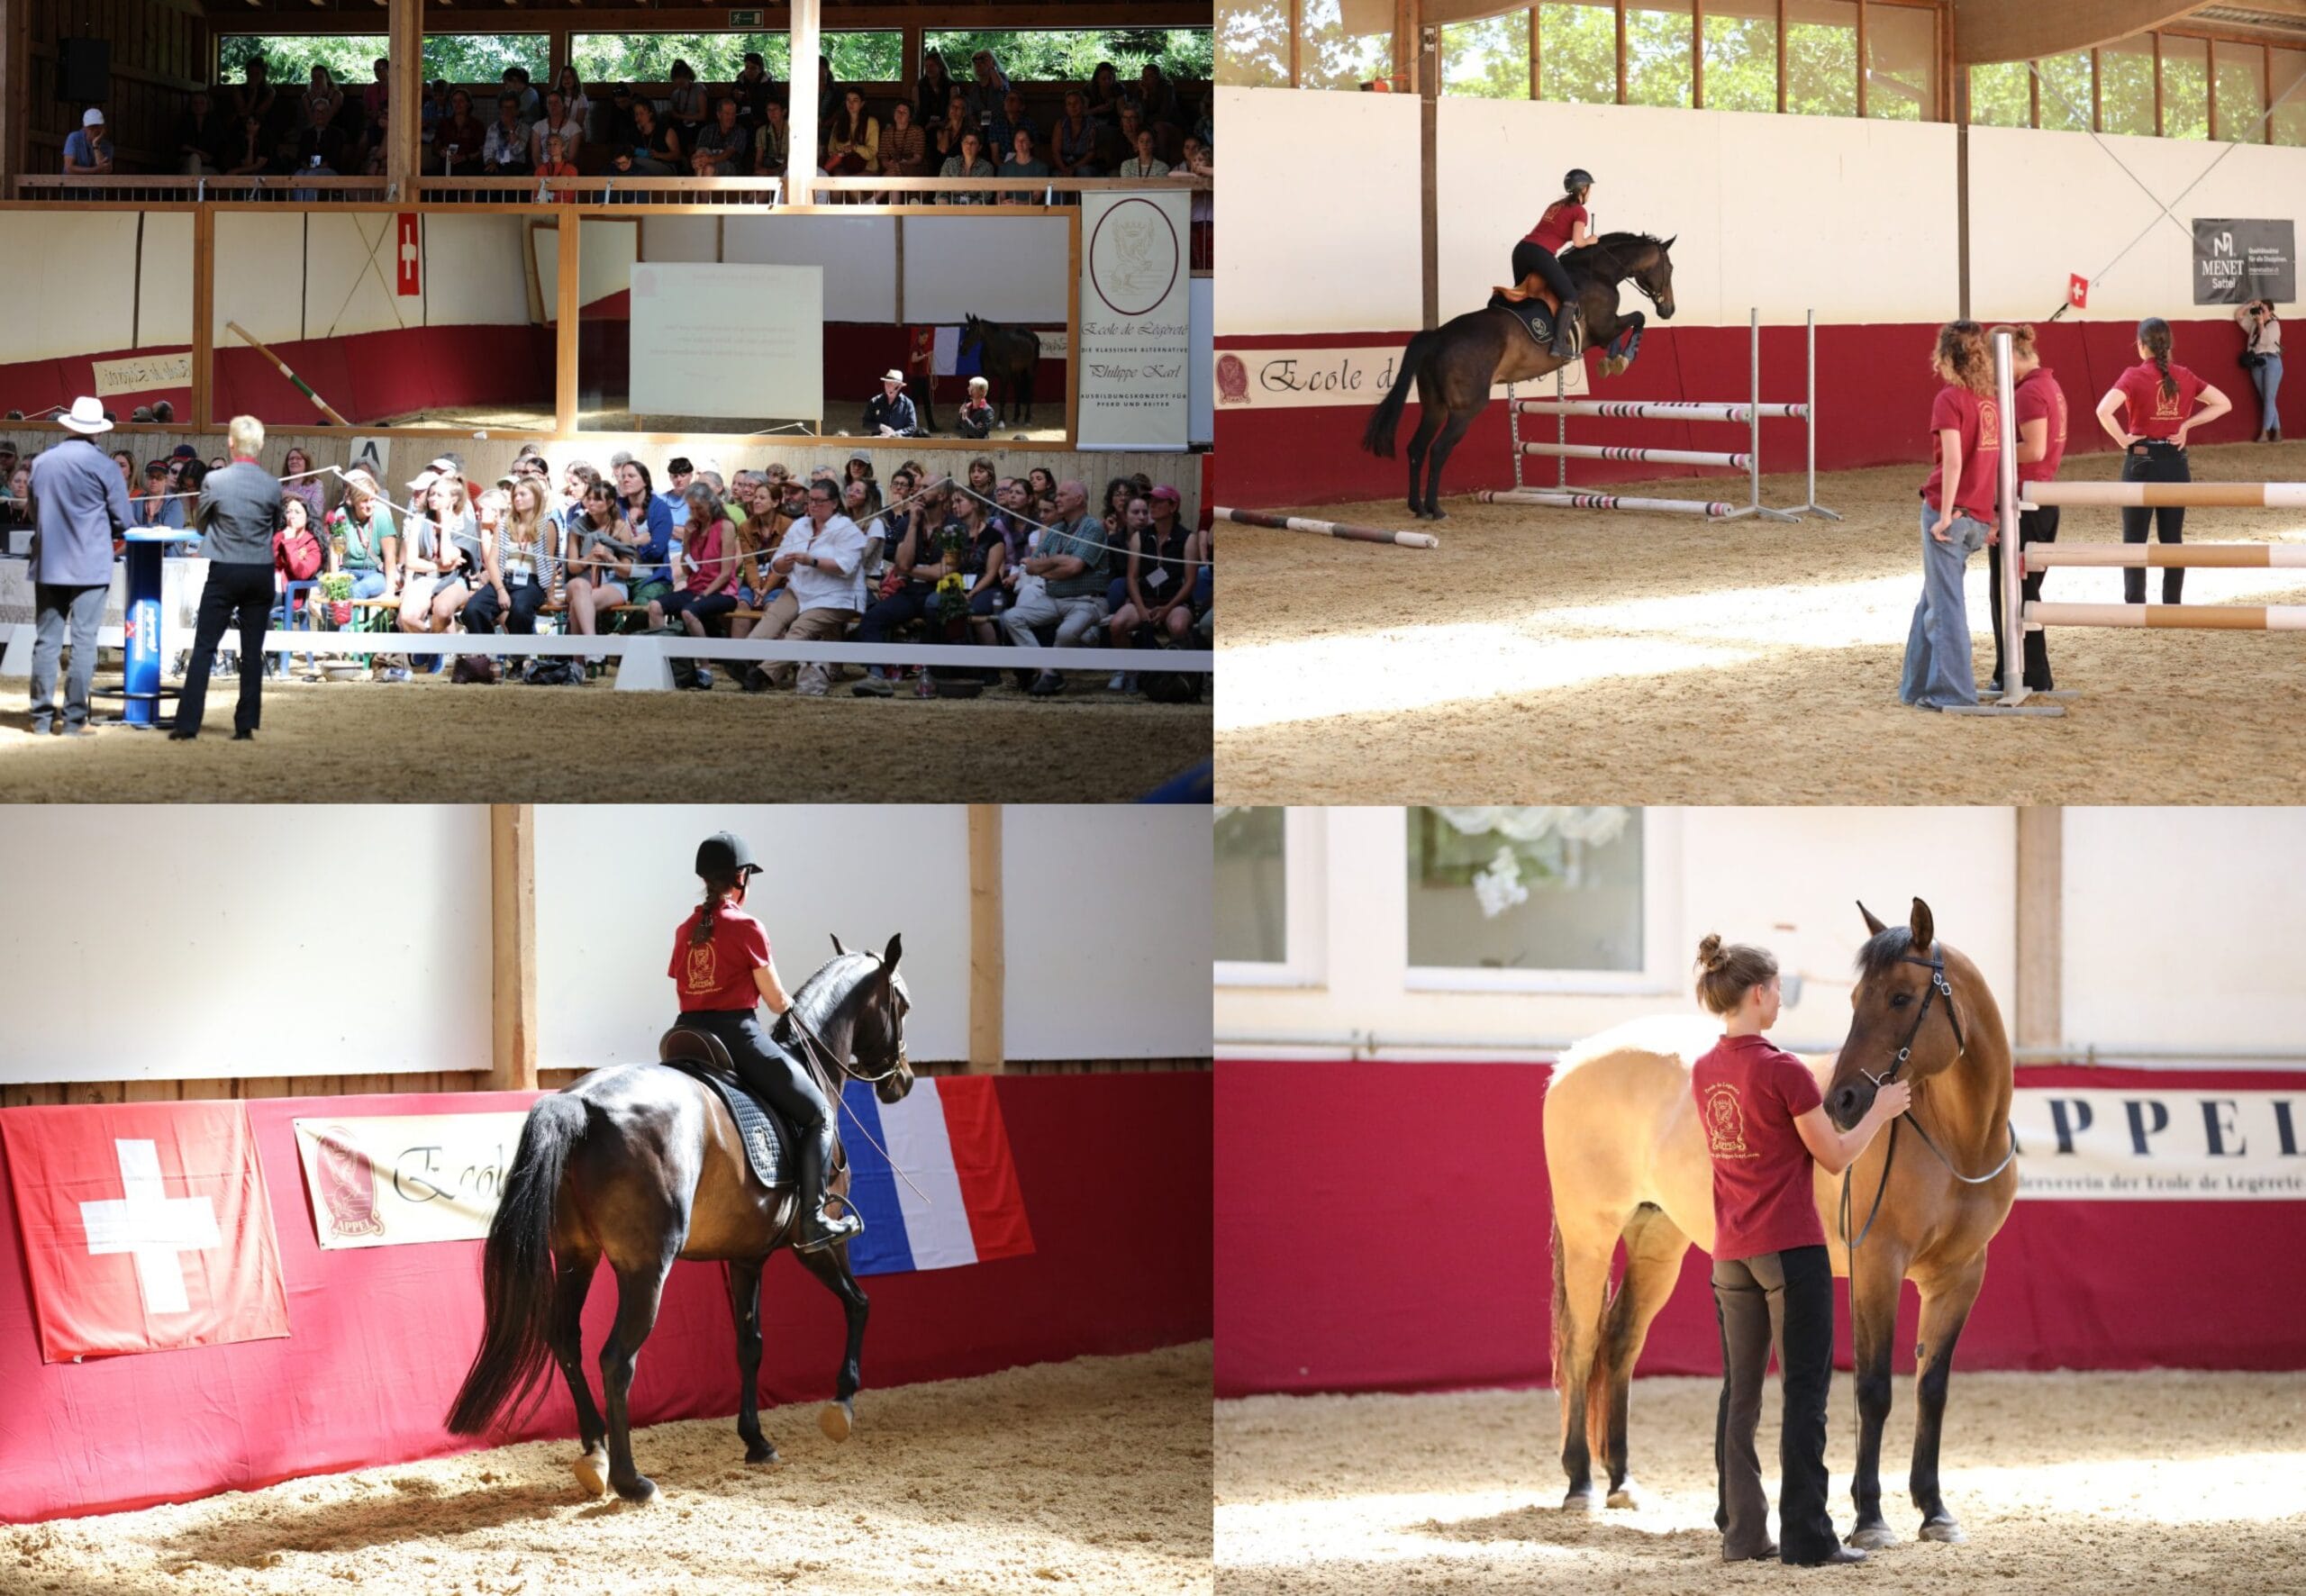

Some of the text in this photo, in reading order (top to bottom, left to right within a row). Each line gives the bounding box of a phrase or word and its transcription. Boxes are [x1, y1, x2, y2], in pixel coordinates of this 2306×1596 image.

[2202, 260, 2244, 276] MENET
[2212, 278, 2236, 289] Sattel
[1081, 322, 1119, 336] Ecole
[1121, 322, 1135, 336] de
[1089, 364, 1182, 383] Philippe Karl
[1260, 357, 1394, 392] Ecole d
[2015, 1099, 2306, 1156] PPEL
[394, 1144, 508, 1202] Ecol
[336, 1219, 373, 1232] APPEL
